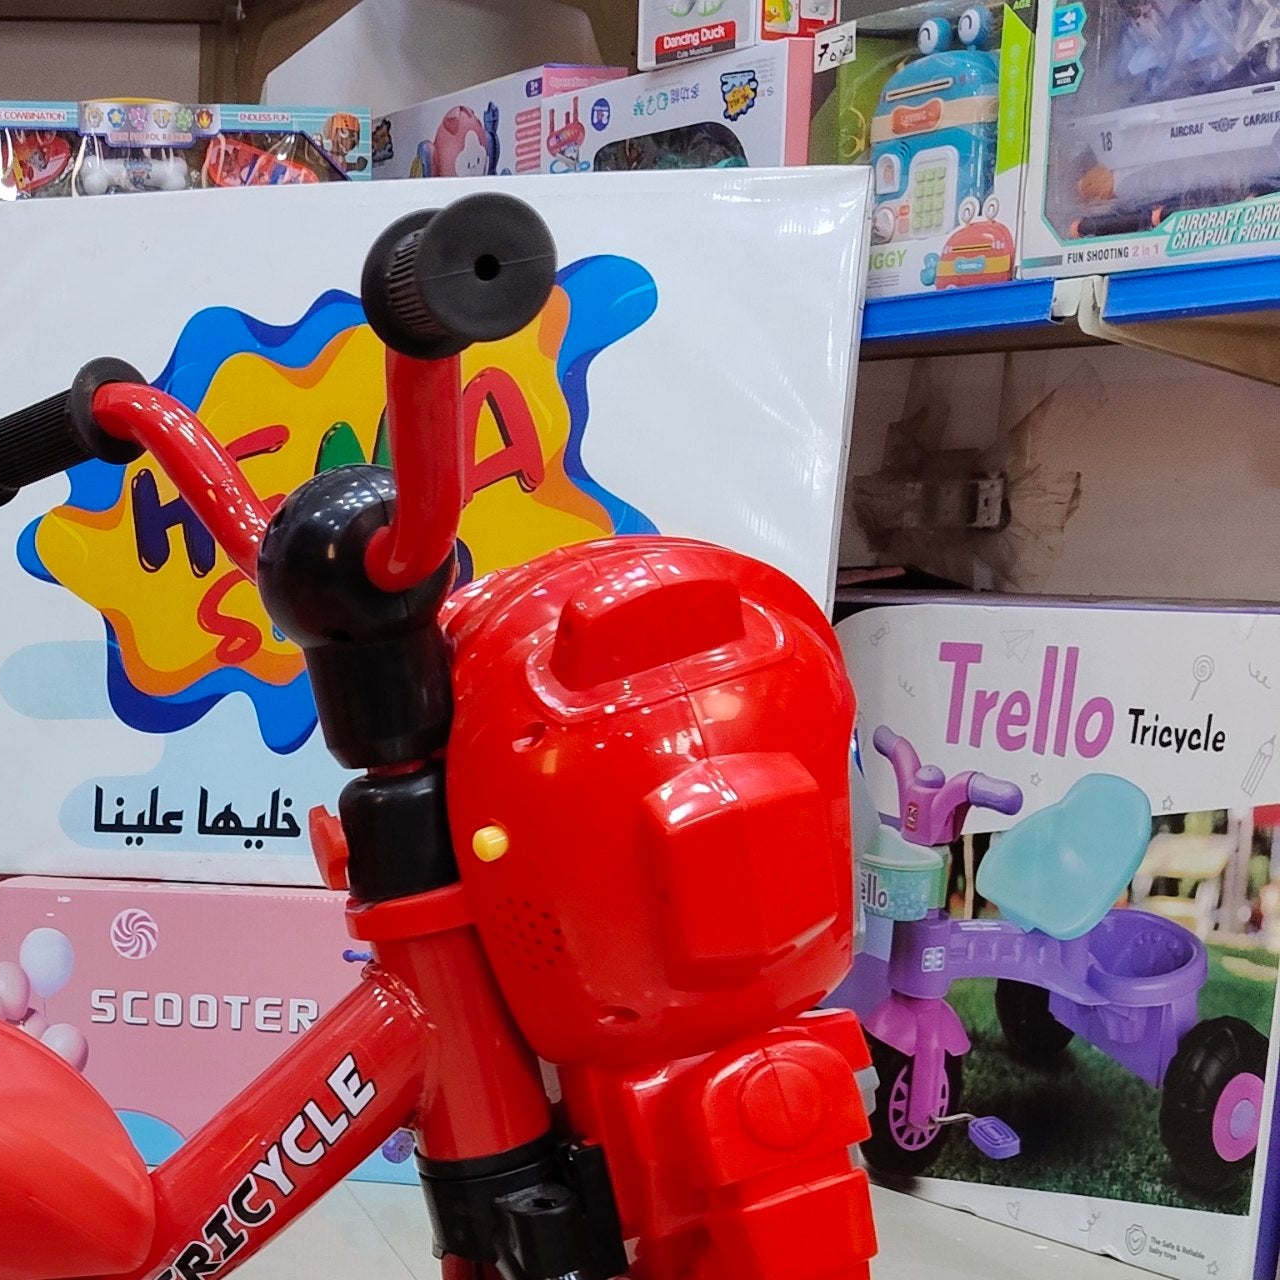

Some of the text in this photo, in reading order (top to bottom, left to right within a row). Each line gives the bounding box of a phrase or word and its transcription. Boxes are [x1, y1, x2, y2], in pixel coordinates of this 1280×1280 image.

[663, 25, 725, 49] Dancing Duck
[4, 111, 66, 121] COMBINATION
[239, 113, 290, 122] ENDLESS FUN
[1100, 131, 1113, 152] 18
[1176, 207, 1244, 232] AIRCRAFT
[1172, 226, 1239, 250] CATAPULT
[1067, 252, 1084, 264] FUN
[1086, 246, 1129, 262] SHOOTING
[938, 641, 1115, 760] Trello
[1128, 708, 1227, 754] Tricycle
[93, 784, 302, 850] خليها علينا
[90, 989, 320, 1033] SCOOTER
